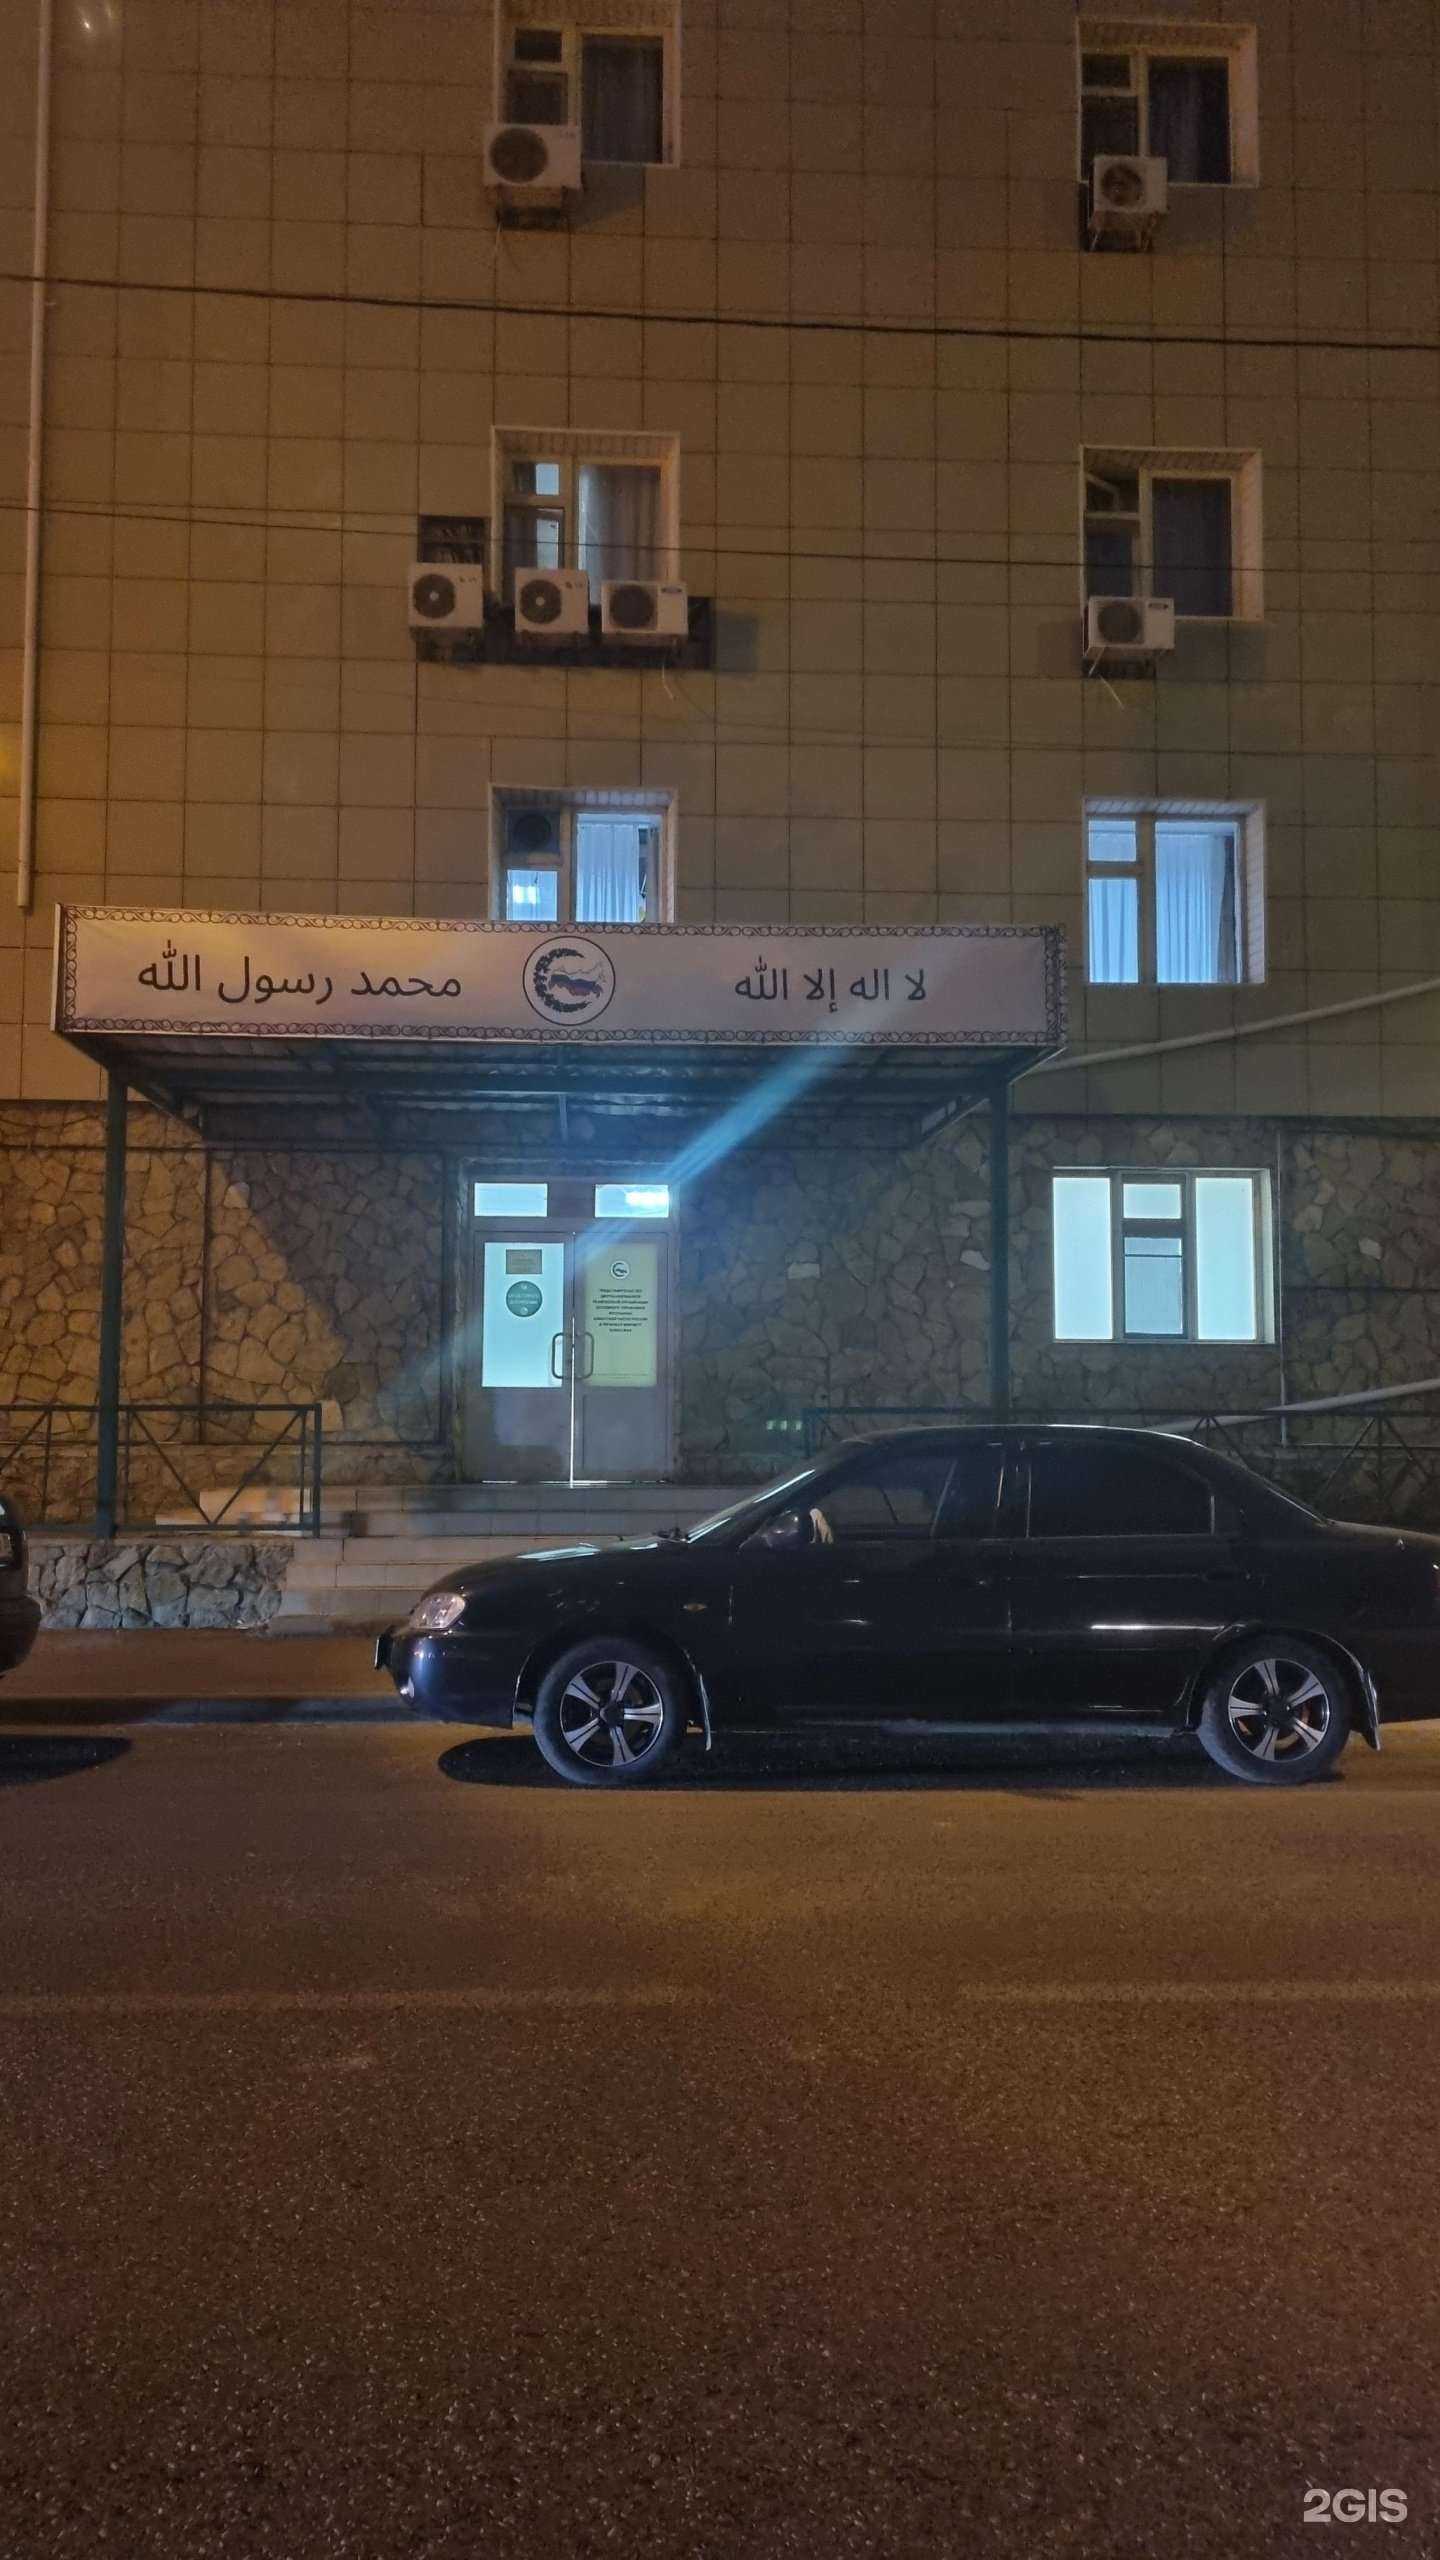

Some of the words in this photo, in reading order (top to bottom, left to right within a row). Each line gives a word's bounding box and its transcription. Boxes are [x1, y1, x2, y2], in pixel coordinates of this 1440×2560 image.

[138, 939, 201, 991] الله
[218, 956, 333, 1005] رسول
[351, 970, 462, 998] محمد
[735, 955, 788, 1000] الله
[850, 968, 889, 1000] اله
[905, 969, 926, 1000] لا
[803, 968, 837, 1013] إلا
